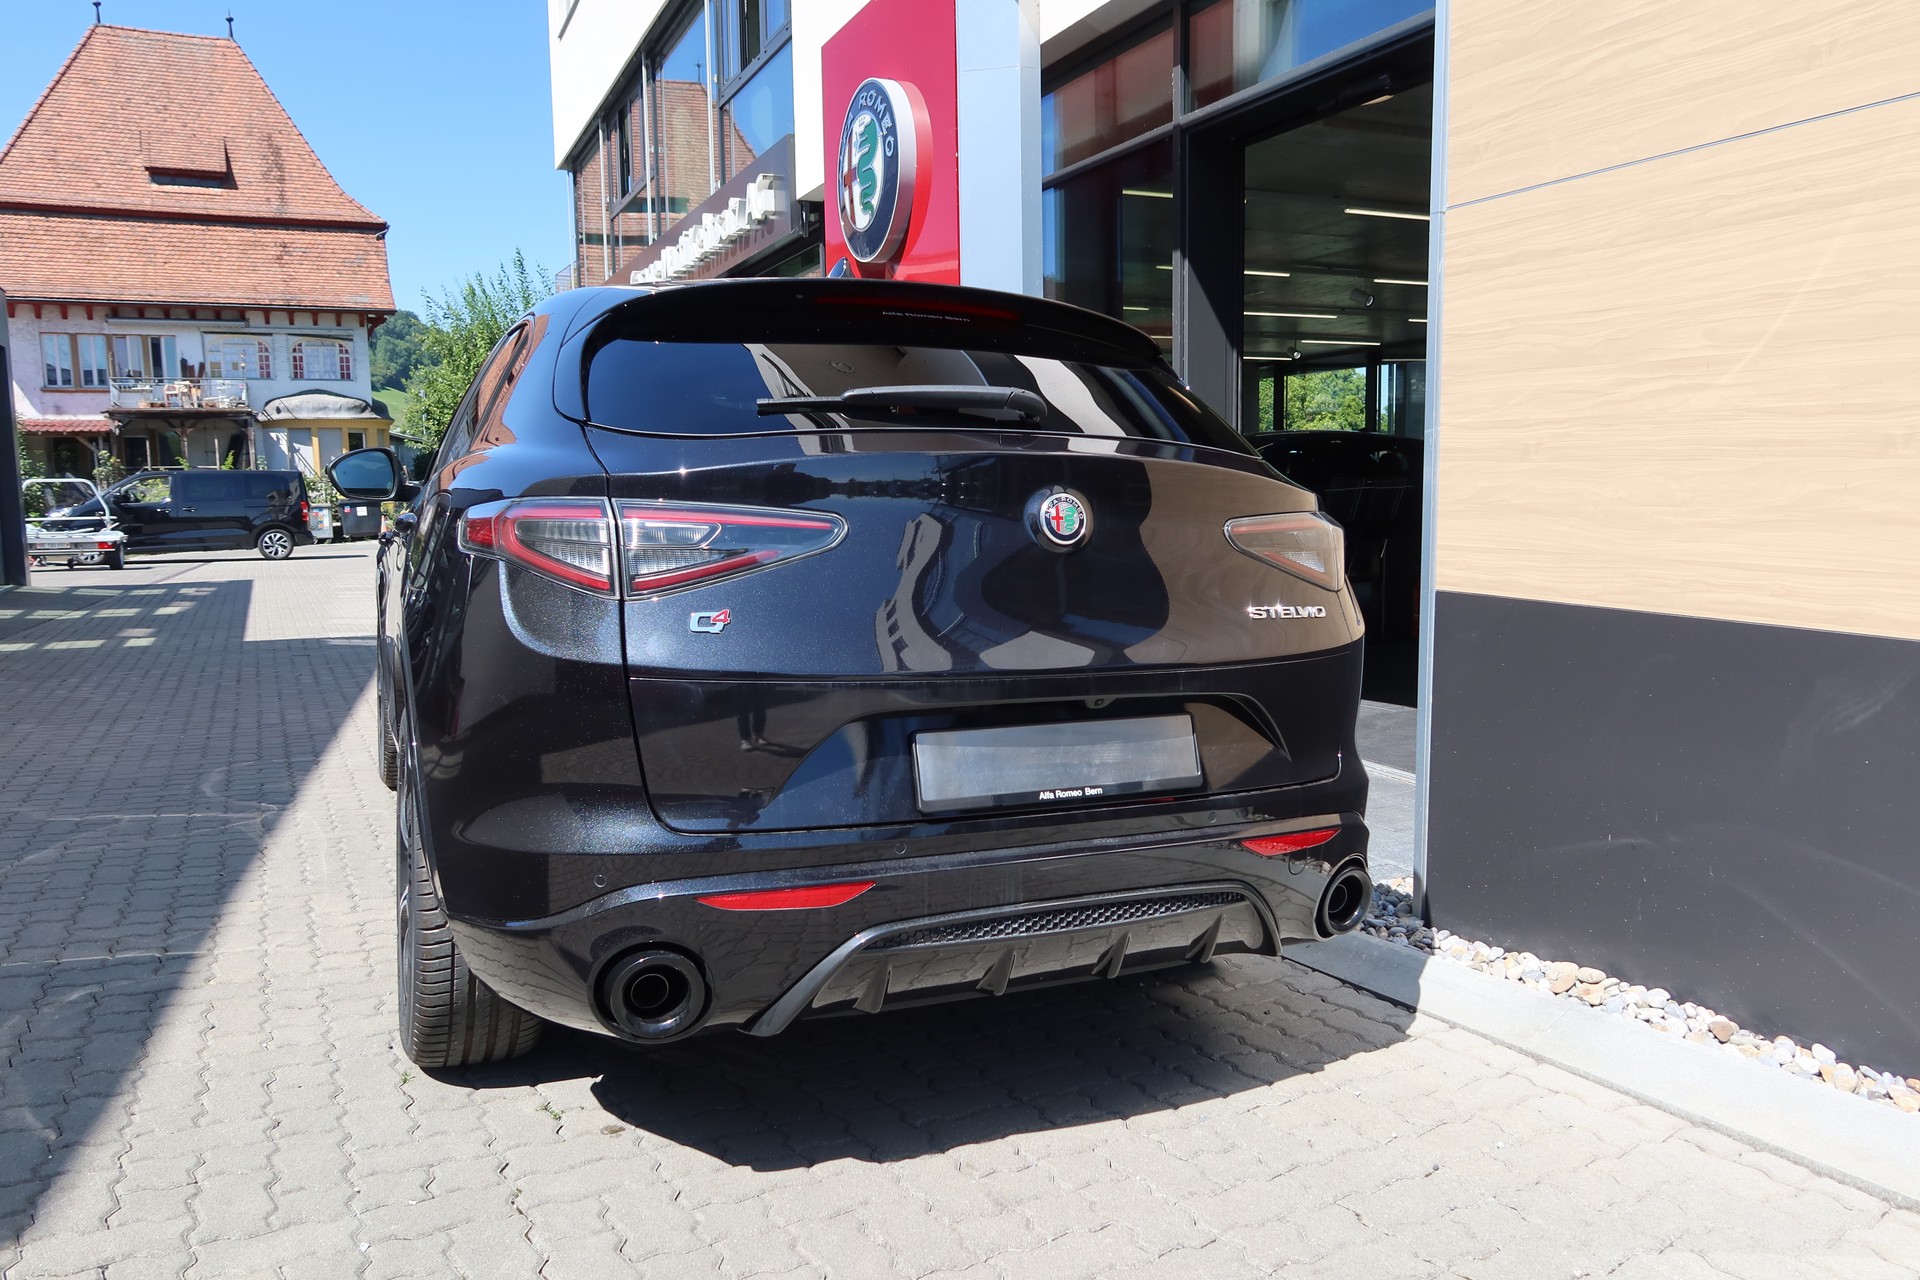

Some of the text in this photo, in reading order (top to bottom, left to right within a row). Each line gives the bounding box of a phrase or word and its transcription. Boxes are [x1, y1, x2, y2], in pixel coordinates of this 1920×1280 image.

[859, 90, 894, 157] ROMEO
[1045, 496, 1084, 520] ALFA ROMEO
[1248, 605, 1326, 619] STELVIO
[1039, 787, 1103, 800] Alfa Romeo Bern
